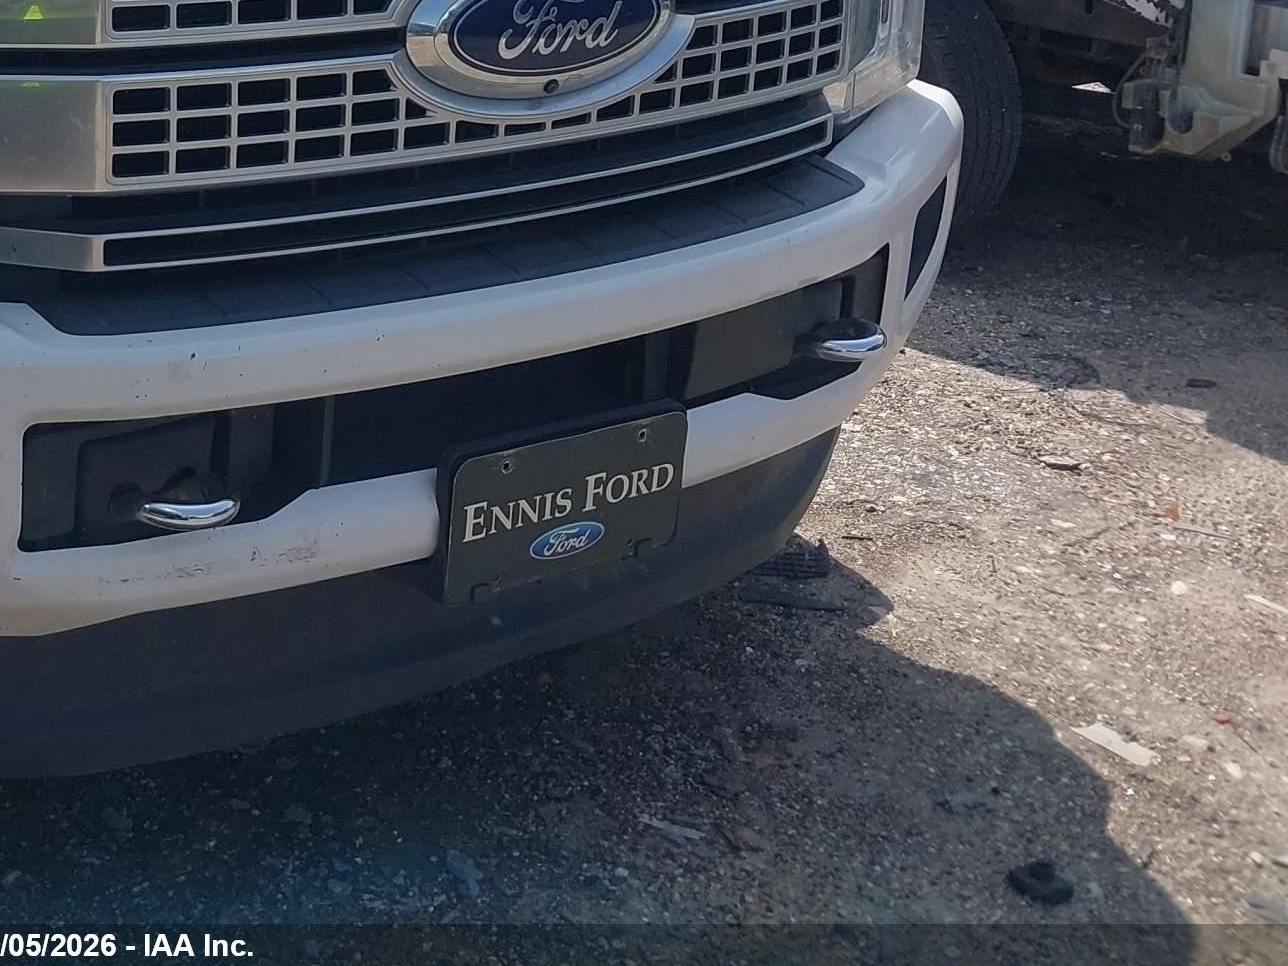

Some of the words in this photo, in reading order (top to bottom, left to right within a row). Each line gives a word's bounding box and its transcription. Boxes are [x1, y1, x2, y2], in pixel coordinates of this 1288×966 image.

[462, 488, 572, 543] ENNIS
[582, 463, 674, 512] FORD
[543, 527, 590, 556] Ford
